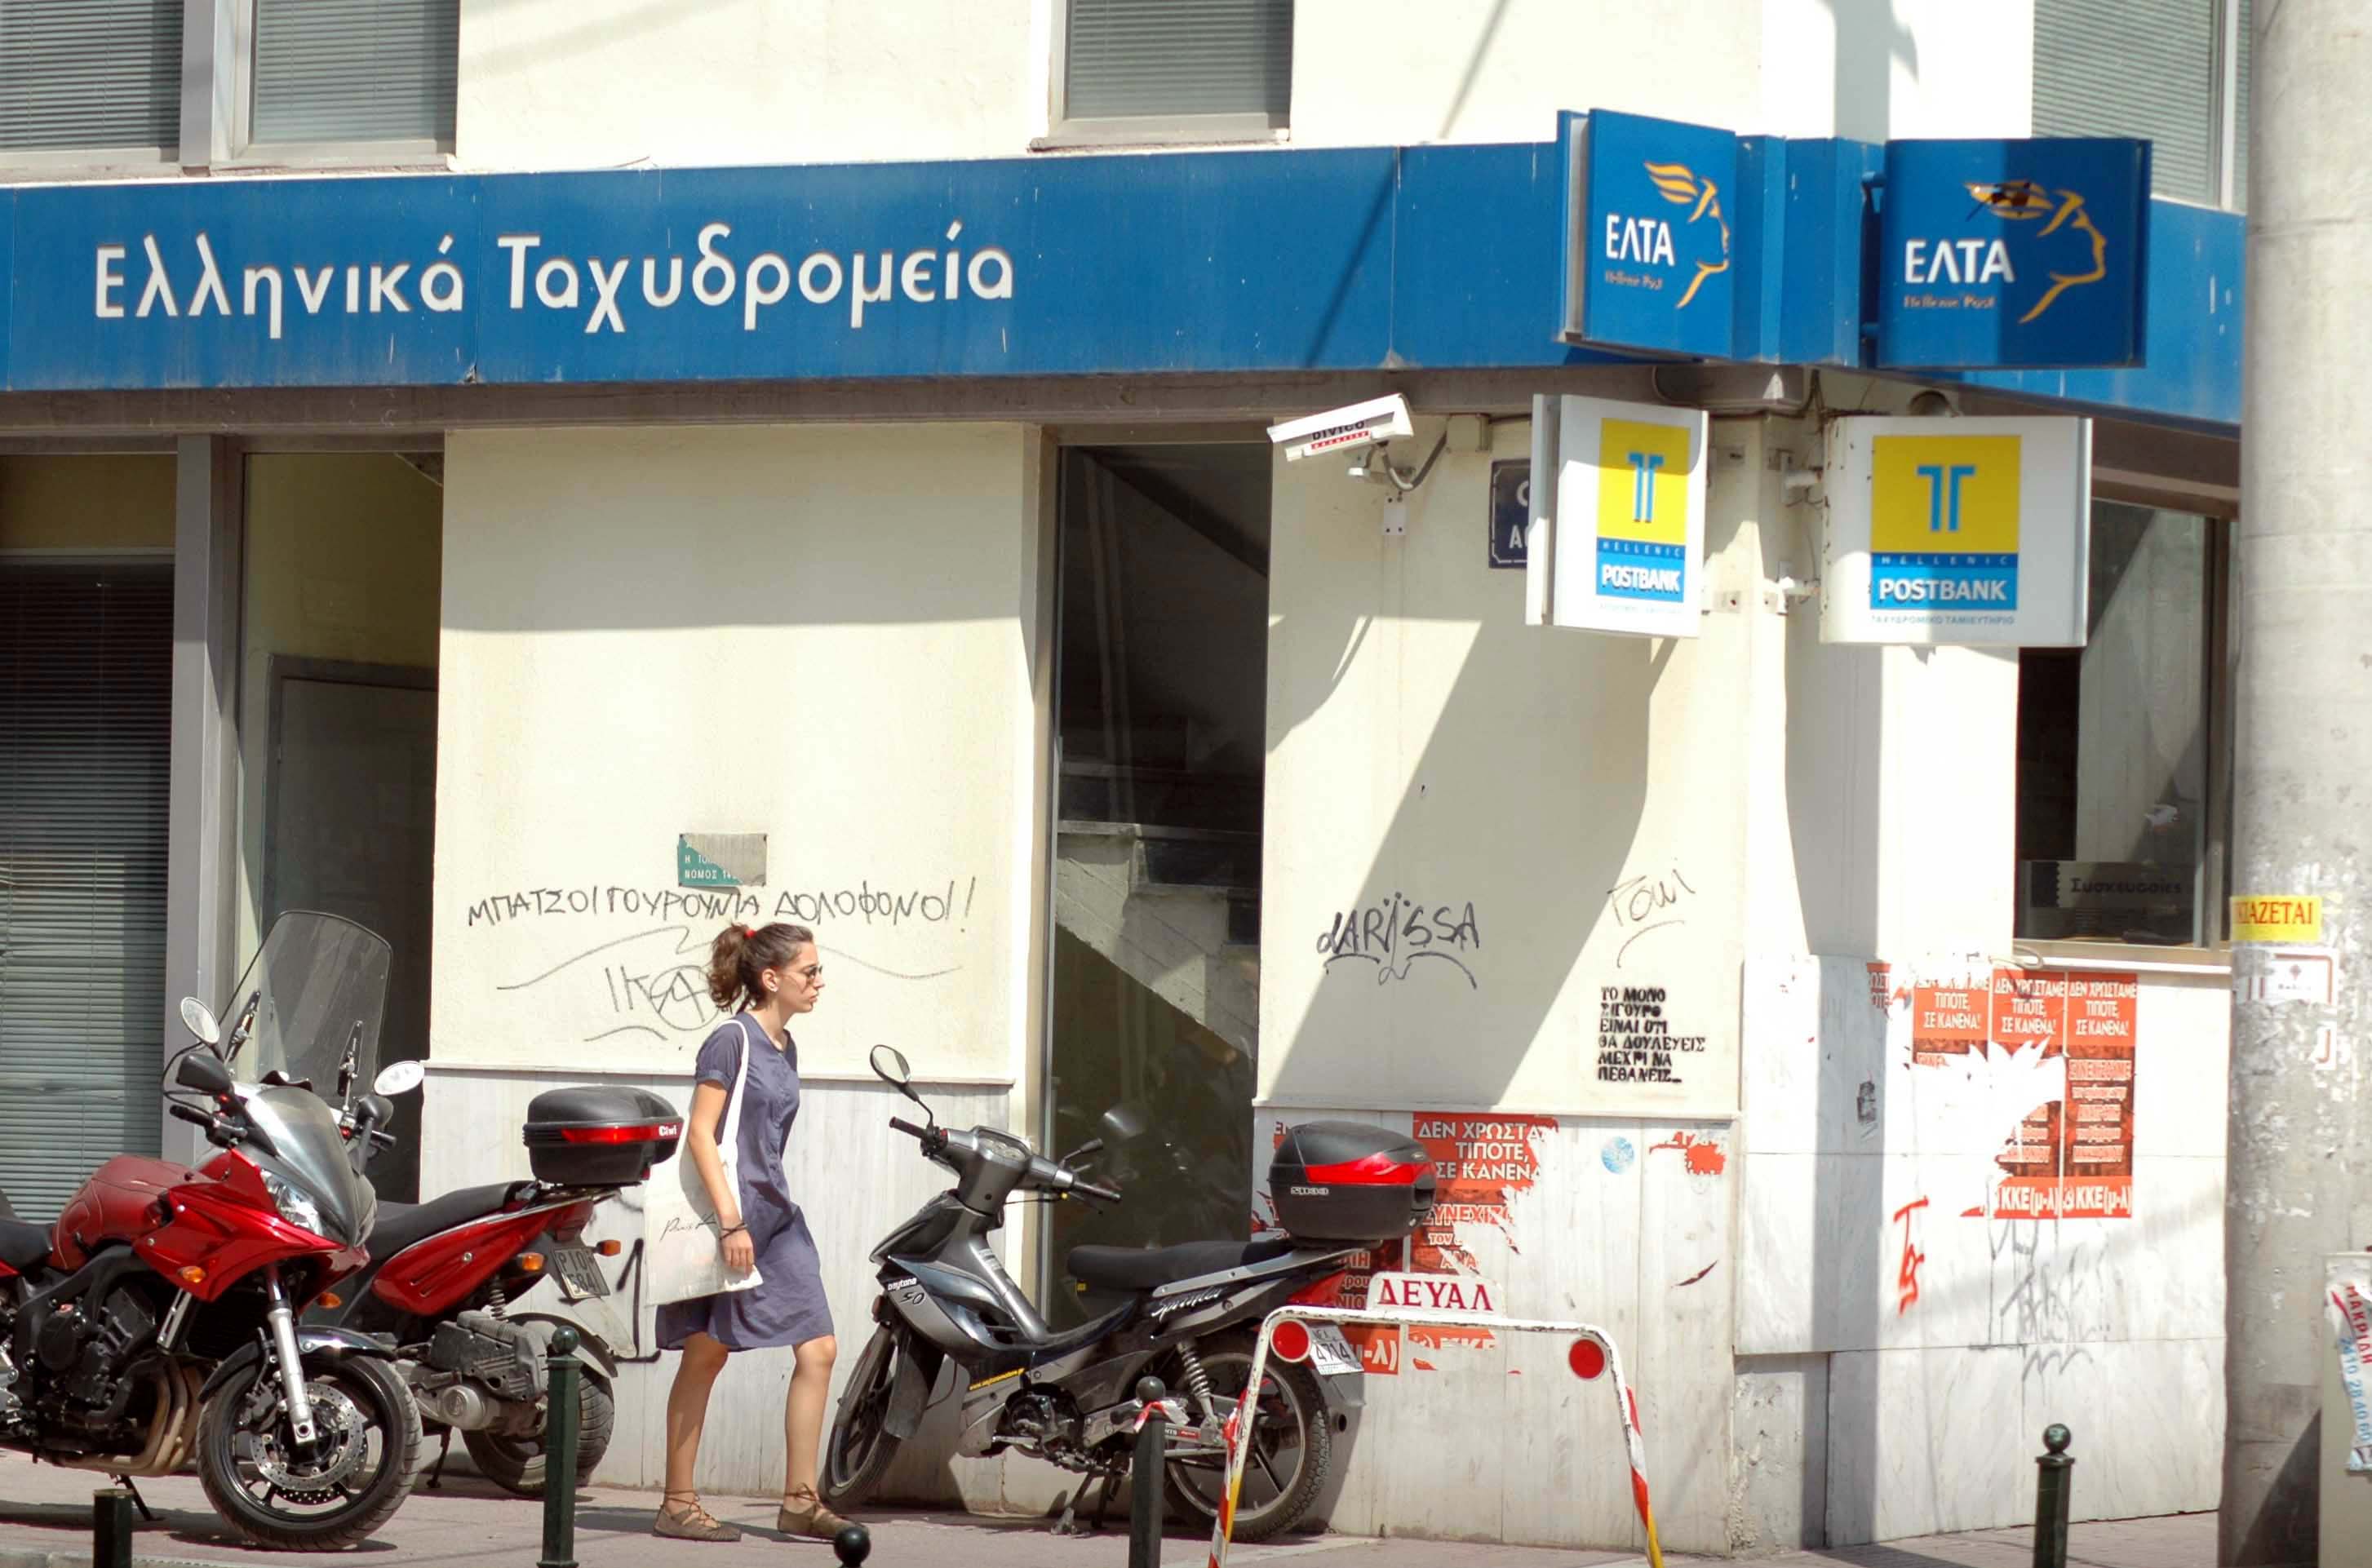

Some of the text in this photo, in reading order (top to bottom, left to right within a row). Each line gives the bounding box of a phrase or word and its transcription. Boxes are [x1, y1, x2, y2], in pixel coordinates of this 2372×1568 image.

[95, 219, 1013, 339] Ελληνικά Ταχυδρομεία
[1881, 555, 2008, 566] HELLENIC
[1601, 564, 1682, 593] POSTBANK
[1878, 578, 2008, 602] POSTBANK
[685, 869, 718, 880] ΝΟΜΟΣ
[468, 885, 598, 927] ΜΠΑΤΣΟΙ
[1601, 986, 1666, 1003] ΤΟ ΜΟΝΟ
[1600, 1002, 1661, 1017] ΣΙΓΟΥΡΟ
[1599, 1018, 1668, 1034] ΕΙΝΑΙ ΟΤΙ
[1598, 1034, 1706, 1052] ΘΑ ΔΟΥΛΕΥΕΙΣ
[1598, 1051, 1672, 1067] ΜΕΧΡΙ ΝΑ
[1418, 1121, 1456, 1139] ΔΕΝ
[1455, 1141, 1529, 1163] ΤΙΠΟΤΕ,
[1435, 1162, 1456, 1179] ΣΕ
[900, 1291, 925, 1305] 50
[1377, 1278, 1494, 1312] ΔΕΥΑΛ
